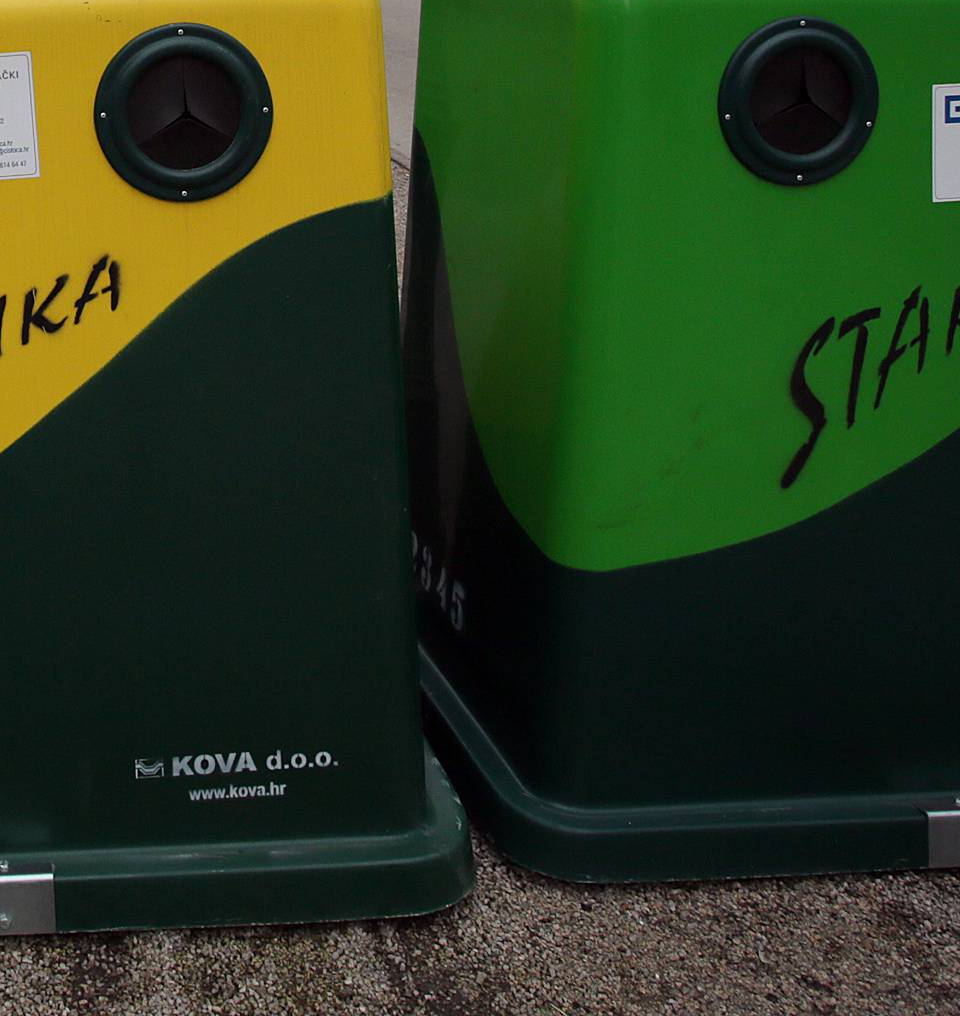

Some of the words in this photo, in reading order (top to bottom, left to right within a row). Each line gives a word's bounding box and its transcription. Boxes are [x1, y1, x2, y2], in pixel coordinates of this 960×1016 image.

[172, 751, 257, 777] KOVA
[266, 749, 339, 770] d.o.o.
[189, 781, 287, 801] www.kova.hr
